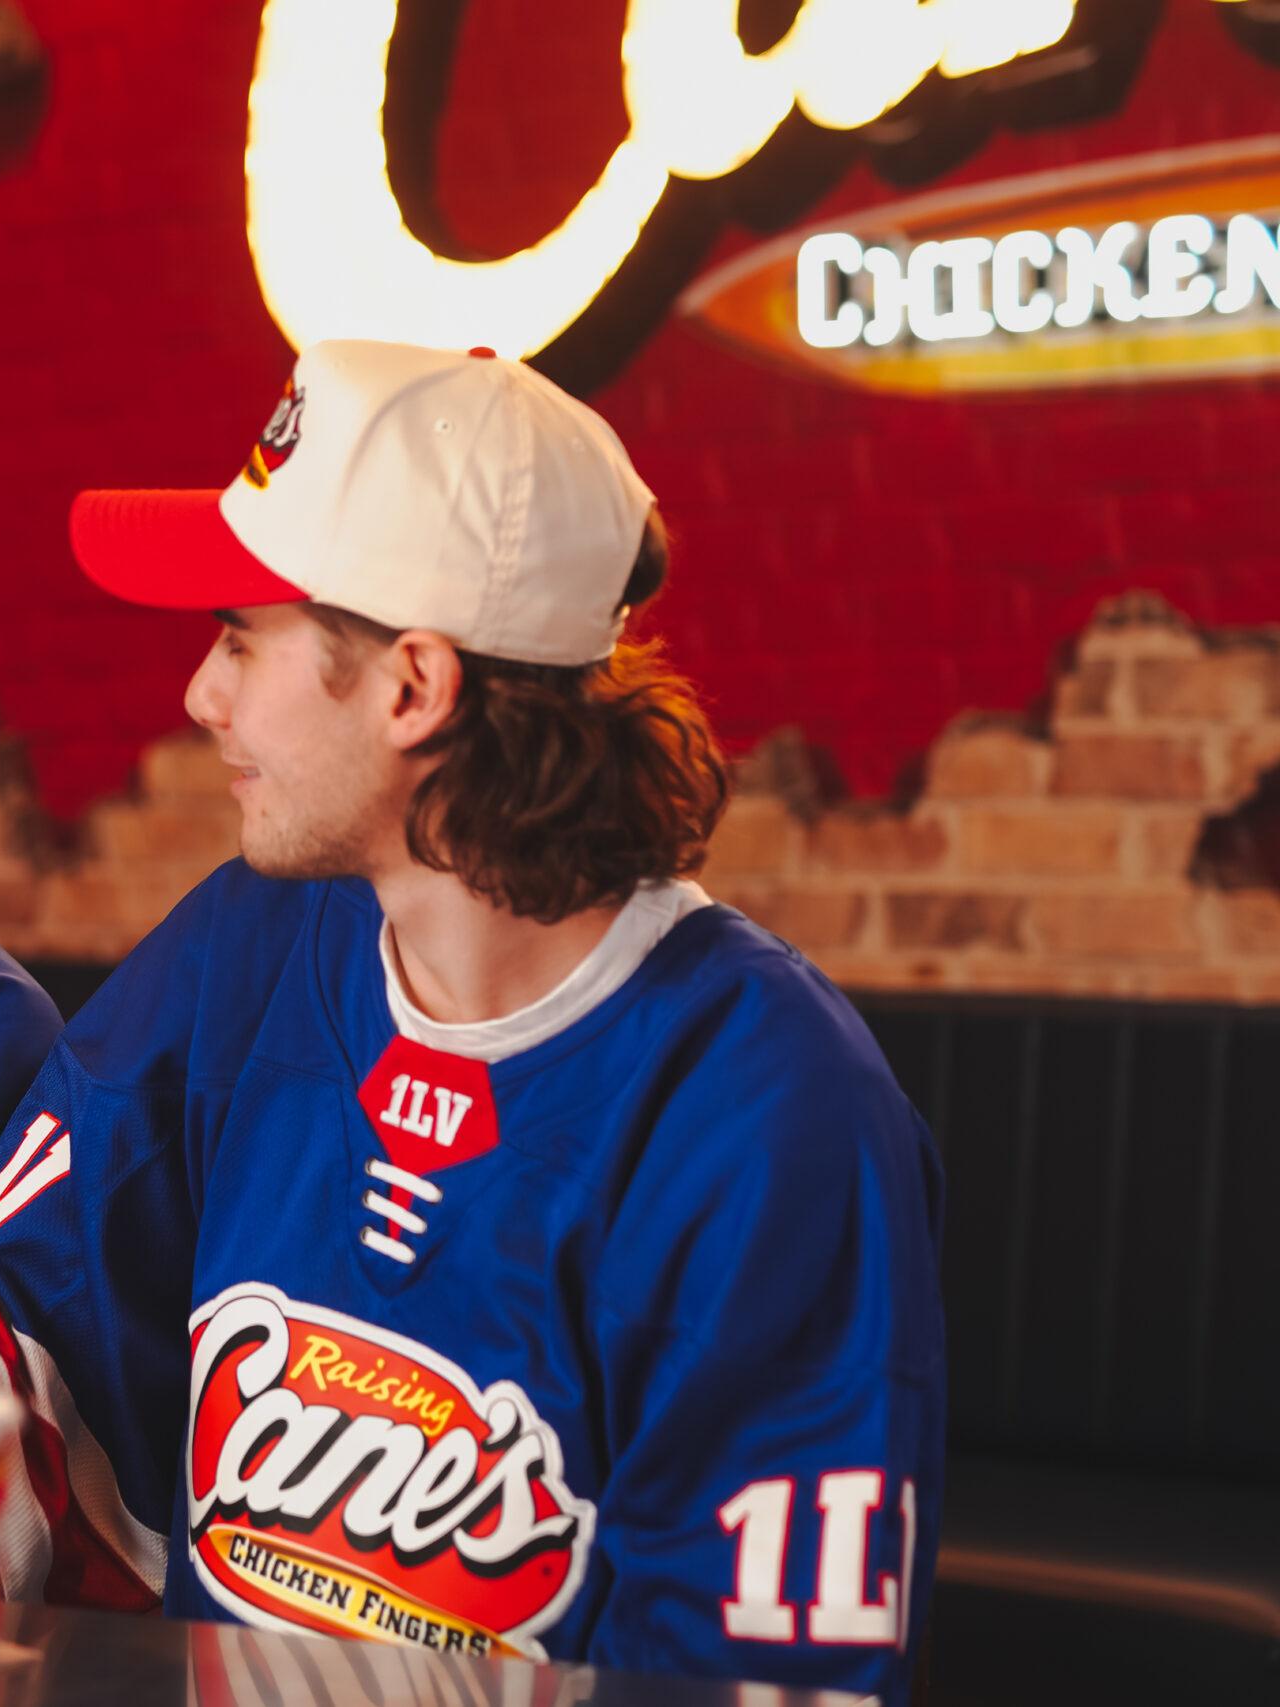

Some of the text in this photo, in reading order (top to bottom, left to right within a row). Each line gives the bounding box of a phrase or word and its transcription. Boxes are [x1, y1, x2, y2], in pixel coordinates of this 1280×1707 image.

[379, 1073, 474, 1148] 1LV
[190, 1295, 576, 1564] Cane's
[288, 1334, 455, 1437] Raising
[228, 1533, 489, 1657] CHICKEN FINGERS
[716, 1467, 916, 1656] 1L
